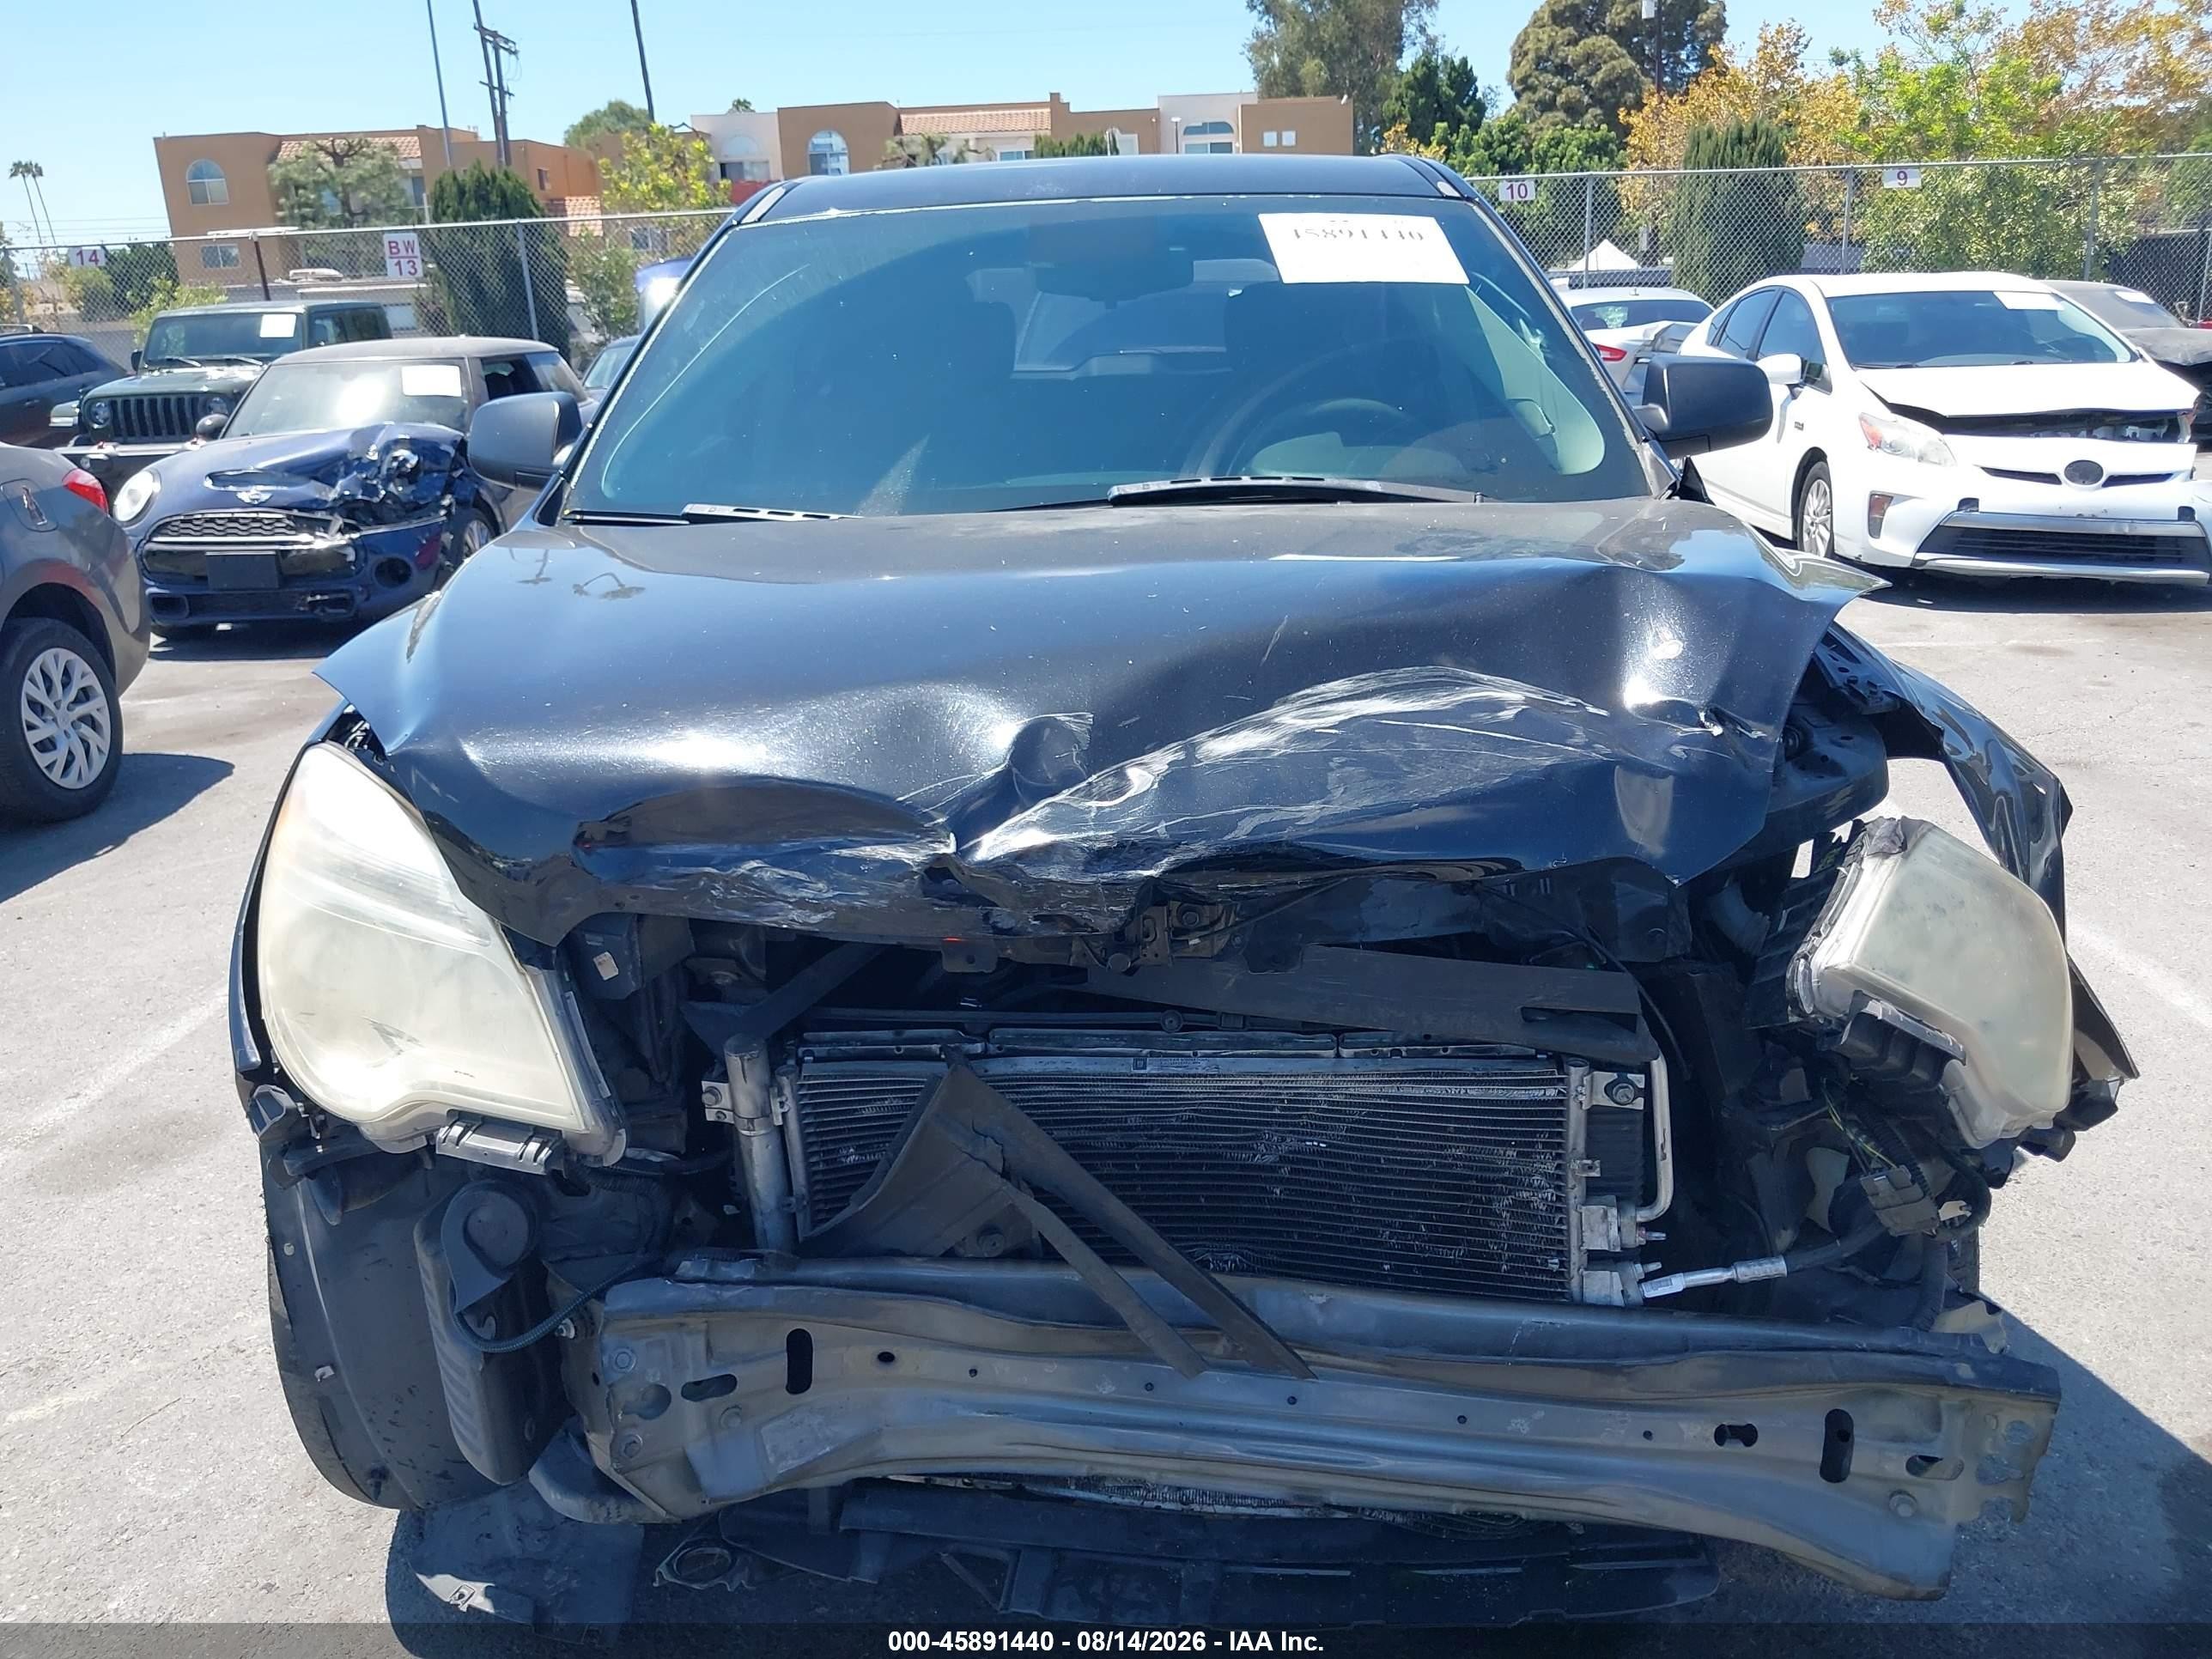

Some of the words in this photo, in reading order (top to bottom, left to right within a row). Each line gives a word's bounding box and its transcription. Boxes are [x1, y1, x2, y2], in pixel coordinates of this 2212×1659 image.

[1897, 171, 1908, 186] 9
[1507, 183, 1528, 200] 10
[388, 240, 415, 255] BW
[76, 249, 100, 265] 14
[394, 260, 417, 276] 13
